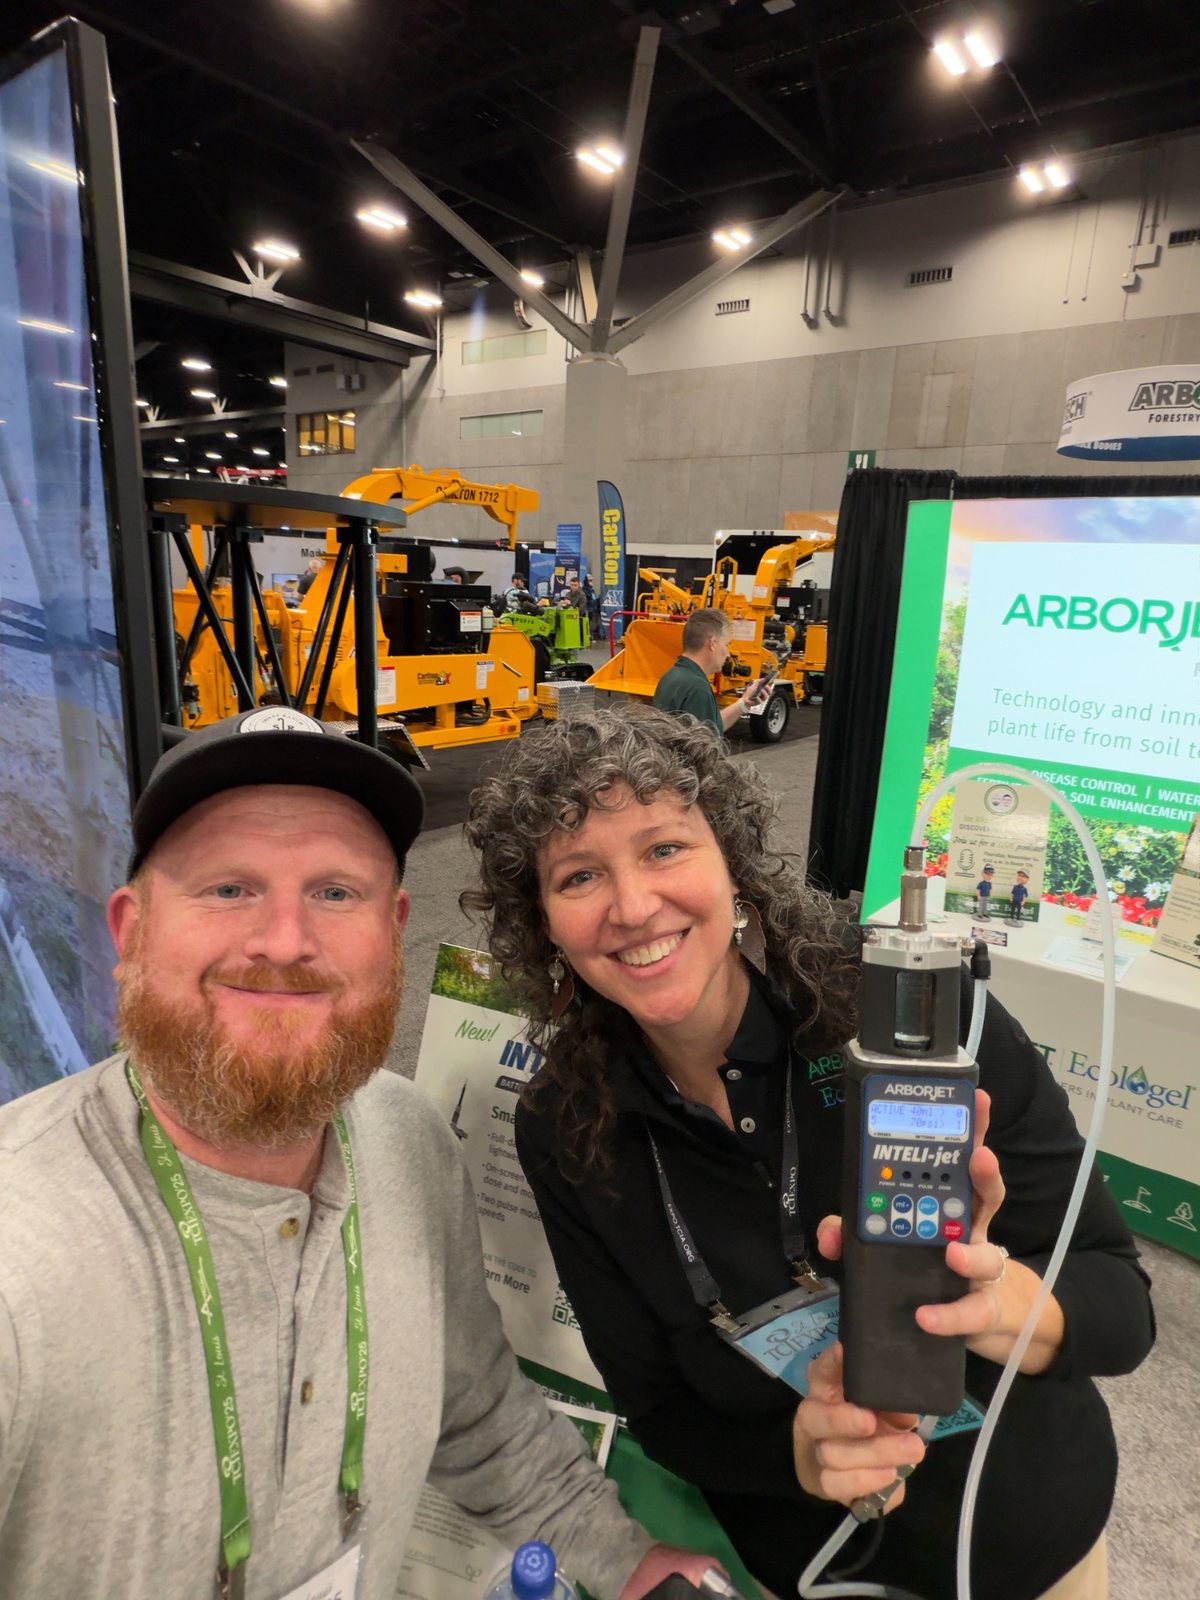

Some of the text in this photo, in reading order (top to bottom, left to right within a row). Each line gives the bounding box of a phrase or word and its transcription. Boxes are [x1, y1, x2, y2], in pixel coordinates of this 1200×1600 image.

[478, 491, 499, 503] 1712
[603, 508, 621, 586] Carlton
[993, 687, 1105, 721] Technology
[1111, 702, 1153, 722] and
[988, 717, 1037, 738] plant
[1043, 722, 1076, 744] life
[1083, 727, 1132, 751] from
[1139, 737, 1181, 758] soil
[1080, 777, 1138, 797] CONTROL
[1069, 791, 1098, 807] SOIL
[1099, 796, 1197, 823] ENHANCEMENT
[454, 1019, 500, 1042] New!
[884, 1083, 956, 1102] ARBORJET
[1146, 1111, 1184, 1130] CARE
[873, 1143, 961, 1168] INTELI-jet
[503, 1275, 530, 1294] More
